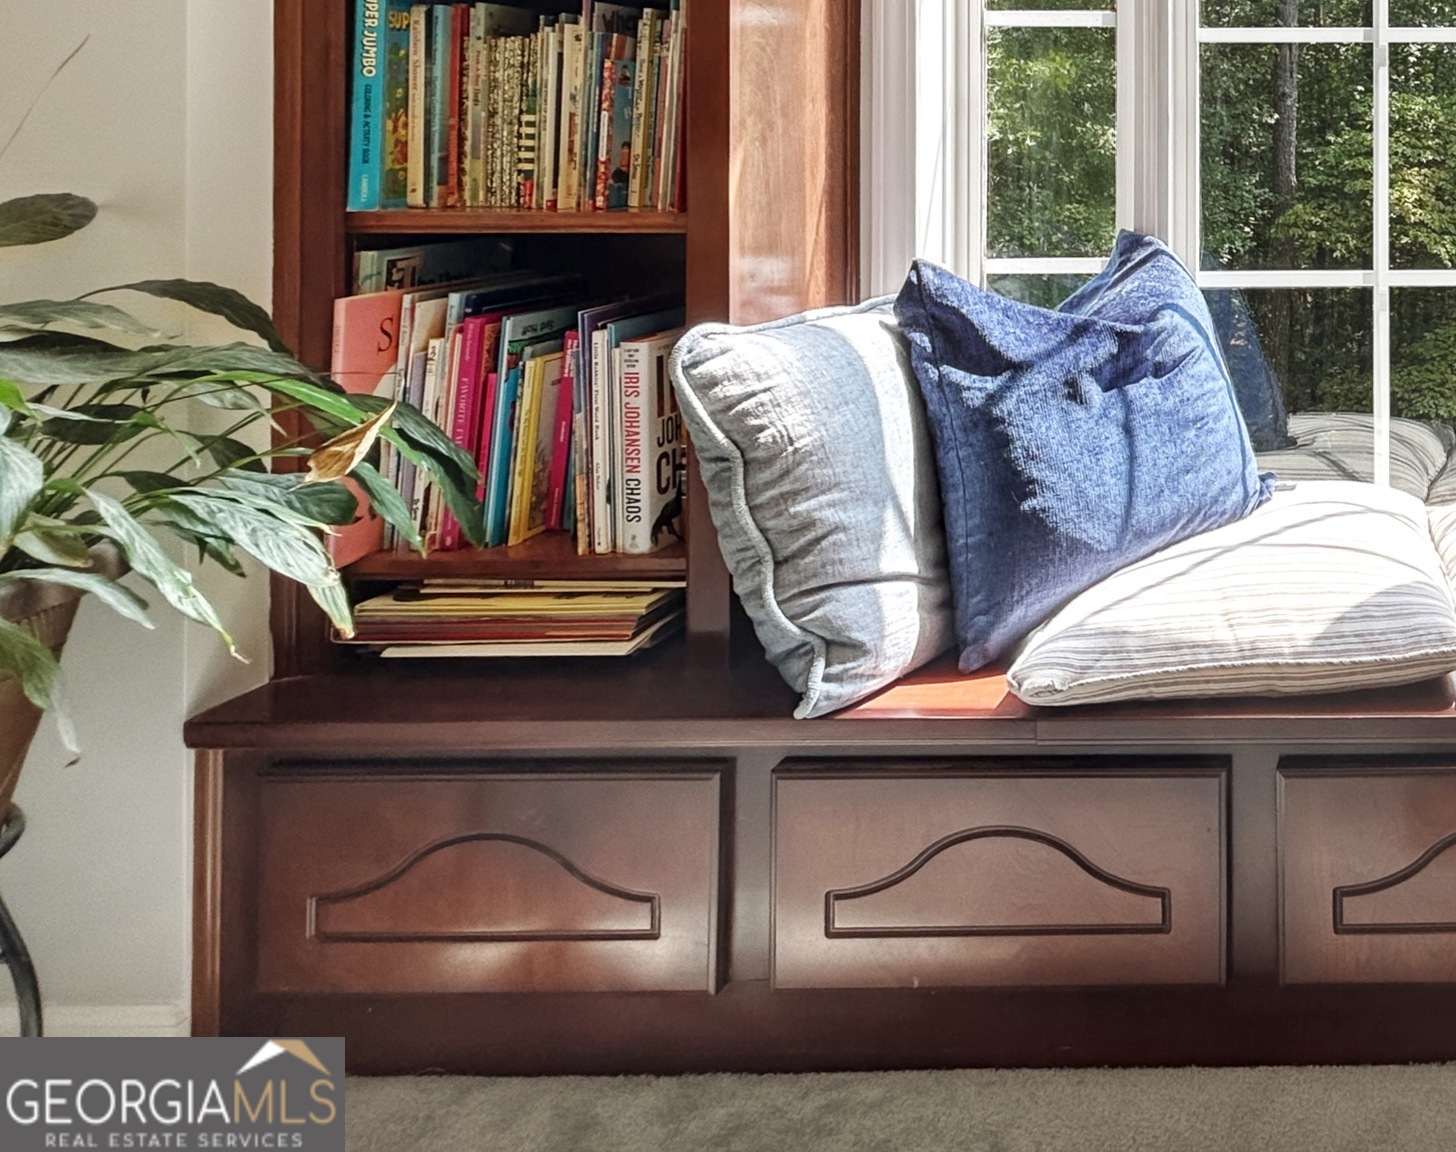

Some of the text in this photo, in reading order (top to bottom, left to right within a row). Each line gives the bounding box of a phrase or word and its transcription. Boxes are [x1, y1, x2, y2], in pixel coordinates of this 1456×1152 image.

[361, 30, 378, 77] JUMBO
[411, 19, 420, 56] Rainbow
[410, 59, 419, 92] Shower
[364, 84, 372, 112] COLORING
[362, 120, 371, 146] ACTIVITY
[457, 377, 469, 426] FAVORITE
[624, 372, 640, 398] IRIS
[624, 402, 640, 473] JOHANSEN
[625, 478, 641, 523] CHAOS
